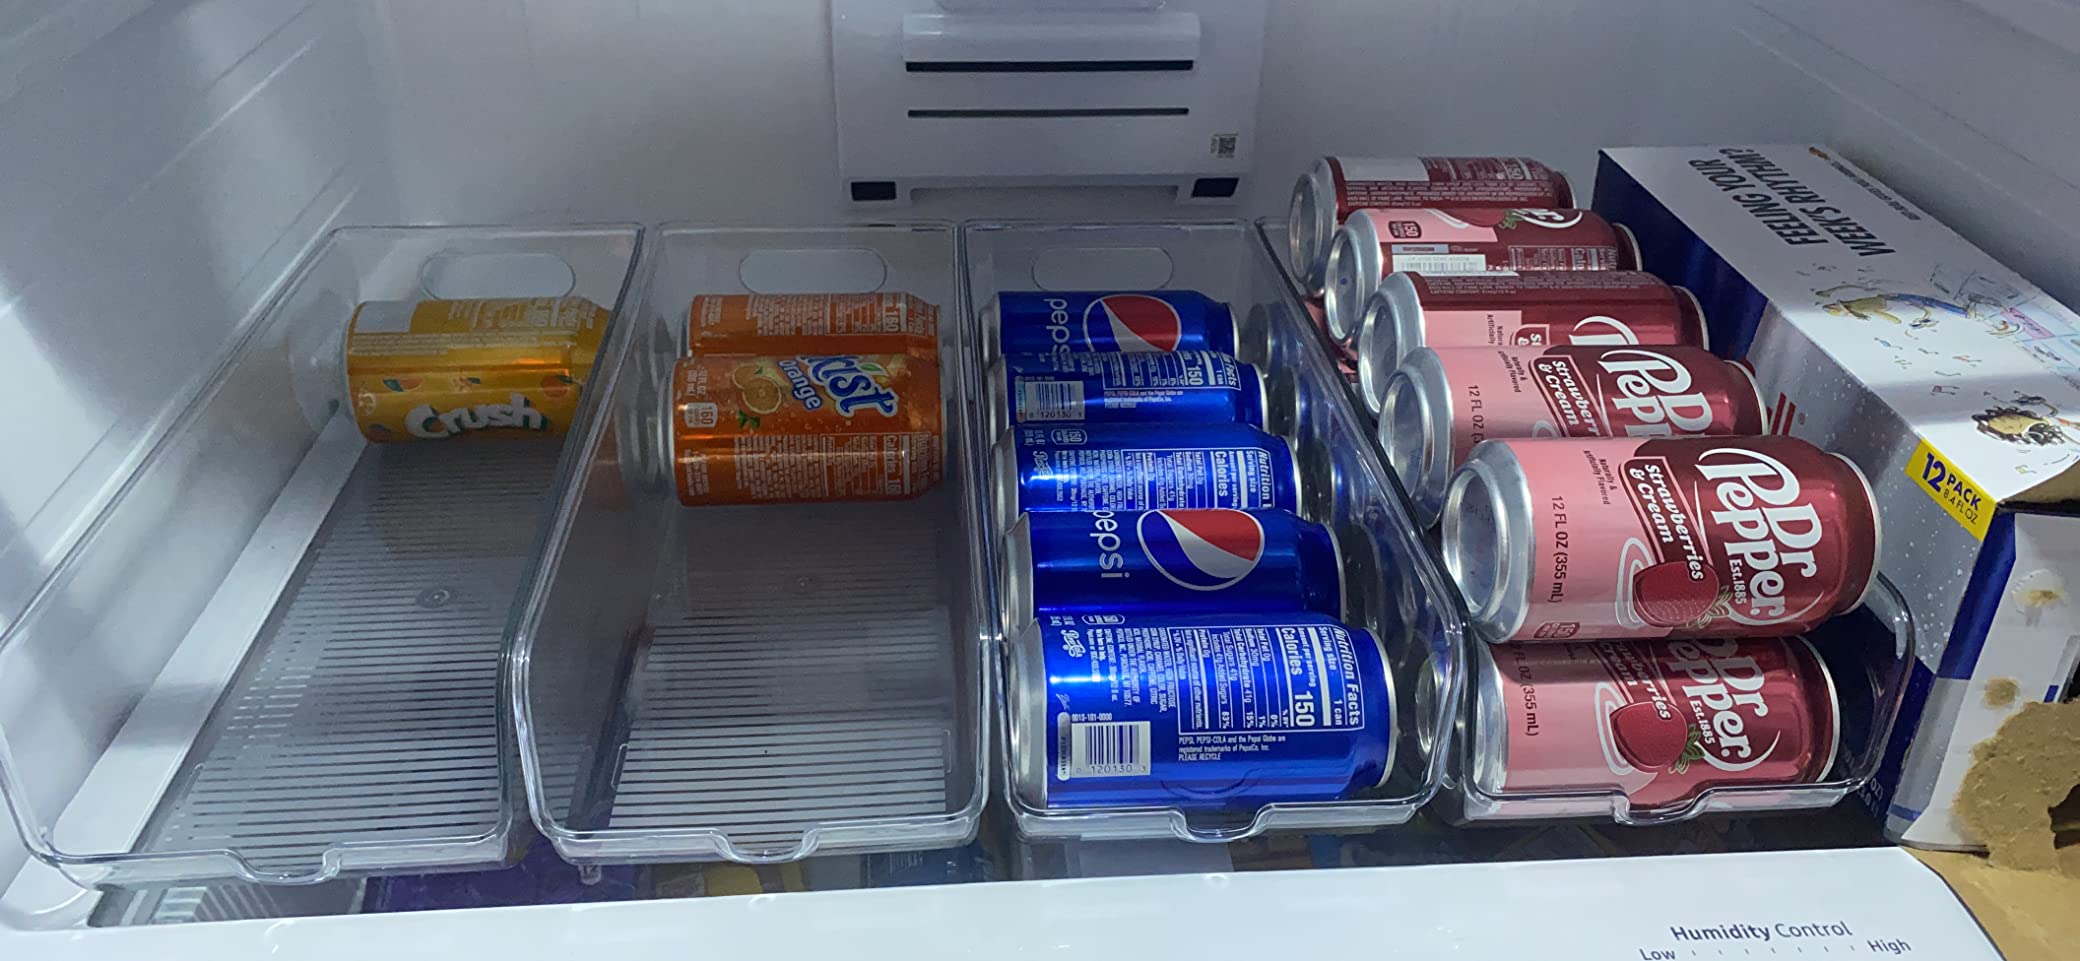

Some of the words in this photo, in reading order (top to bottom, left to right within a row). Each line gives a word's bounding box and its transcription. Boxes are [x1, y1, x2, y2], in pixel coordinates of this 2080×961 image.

[1688, 158, 1755, 191] YOUR
[1719, 148, 1826, 203] RHYTHM?
[1733, 194, 1829, 246] FEELING
[1799, 206, 1896, 256] WEEK'S
[778, 360, 822, 410] Orange
[1188, 366, 1204, 386] 150
[1468, 384, 1480, 397] 12
[1545, 374, 1580, 426] Cream
[1552, 360, 1600, 436] Strawberr
[405, 392, 547, 439] Crush
[1470, 399, 1483, 412] FL
[1472, 414, 1485, 429] OZ
[1215, 451, 1230, 497] Calories
[1245, 450, 1256, 476] Serving
[1258, 450, 1272, 500] Nutrition
[1629, 467, 1646, 481] &
[1596, 476, 1611, 505] Flavored
[1922, 451, 1946, 493] 12
[1946, 473, 1982, 511] PACK
[1551, 495, 1565, 510] 12
[1637, 482, 1674, 544] Cream
[1554, 513, 1567, 529] FL
[1644, 464, 1704, 580] Strawberries
[1965, 508, 1978, 525] OZ
[1555, 531, 1569, 549] OZ
[1761, 502, 1823, 577] Dr
[1553, 551, 1569, 580] (355
[1546, 582, 1564, 604] mL)
[1236, 642, 1252, 688] Carbohydrate
[1281, 627, 1303, 676] Calories
[1294, 690, 1315, 727] 150
[1318, 626, 1333, 652] Serving
[1326, 653, 1337, 671] size
[1334, 708, 1343, 726] can
[1332, 627, 1355, 680] Nutrition
[1346, 683, 1361, 726] Facts
[1518, 665, 1532, 680] OZ
[1243, 689, 1253, 704] 41g
[1520, 683, 1537, 710] (355
[1711, 655, 1769, 717] Dr
[1246, 711, 1254, 728] 15%
[1258, 715, 1267, 728] 1%
[1525, 712, 1539, 737] mL)
[1227, 735, 1237, 743] and
[1091, 764, 1133, 774] 120130
[1178, 753, 1198, 761] PLEASE
[1670, 923, 1771, 942] Humidity
[1774, 920, 1853, 938] Control
[1639, 948, 1676, 961] Low
[1867, 938, 1912, 955] High
